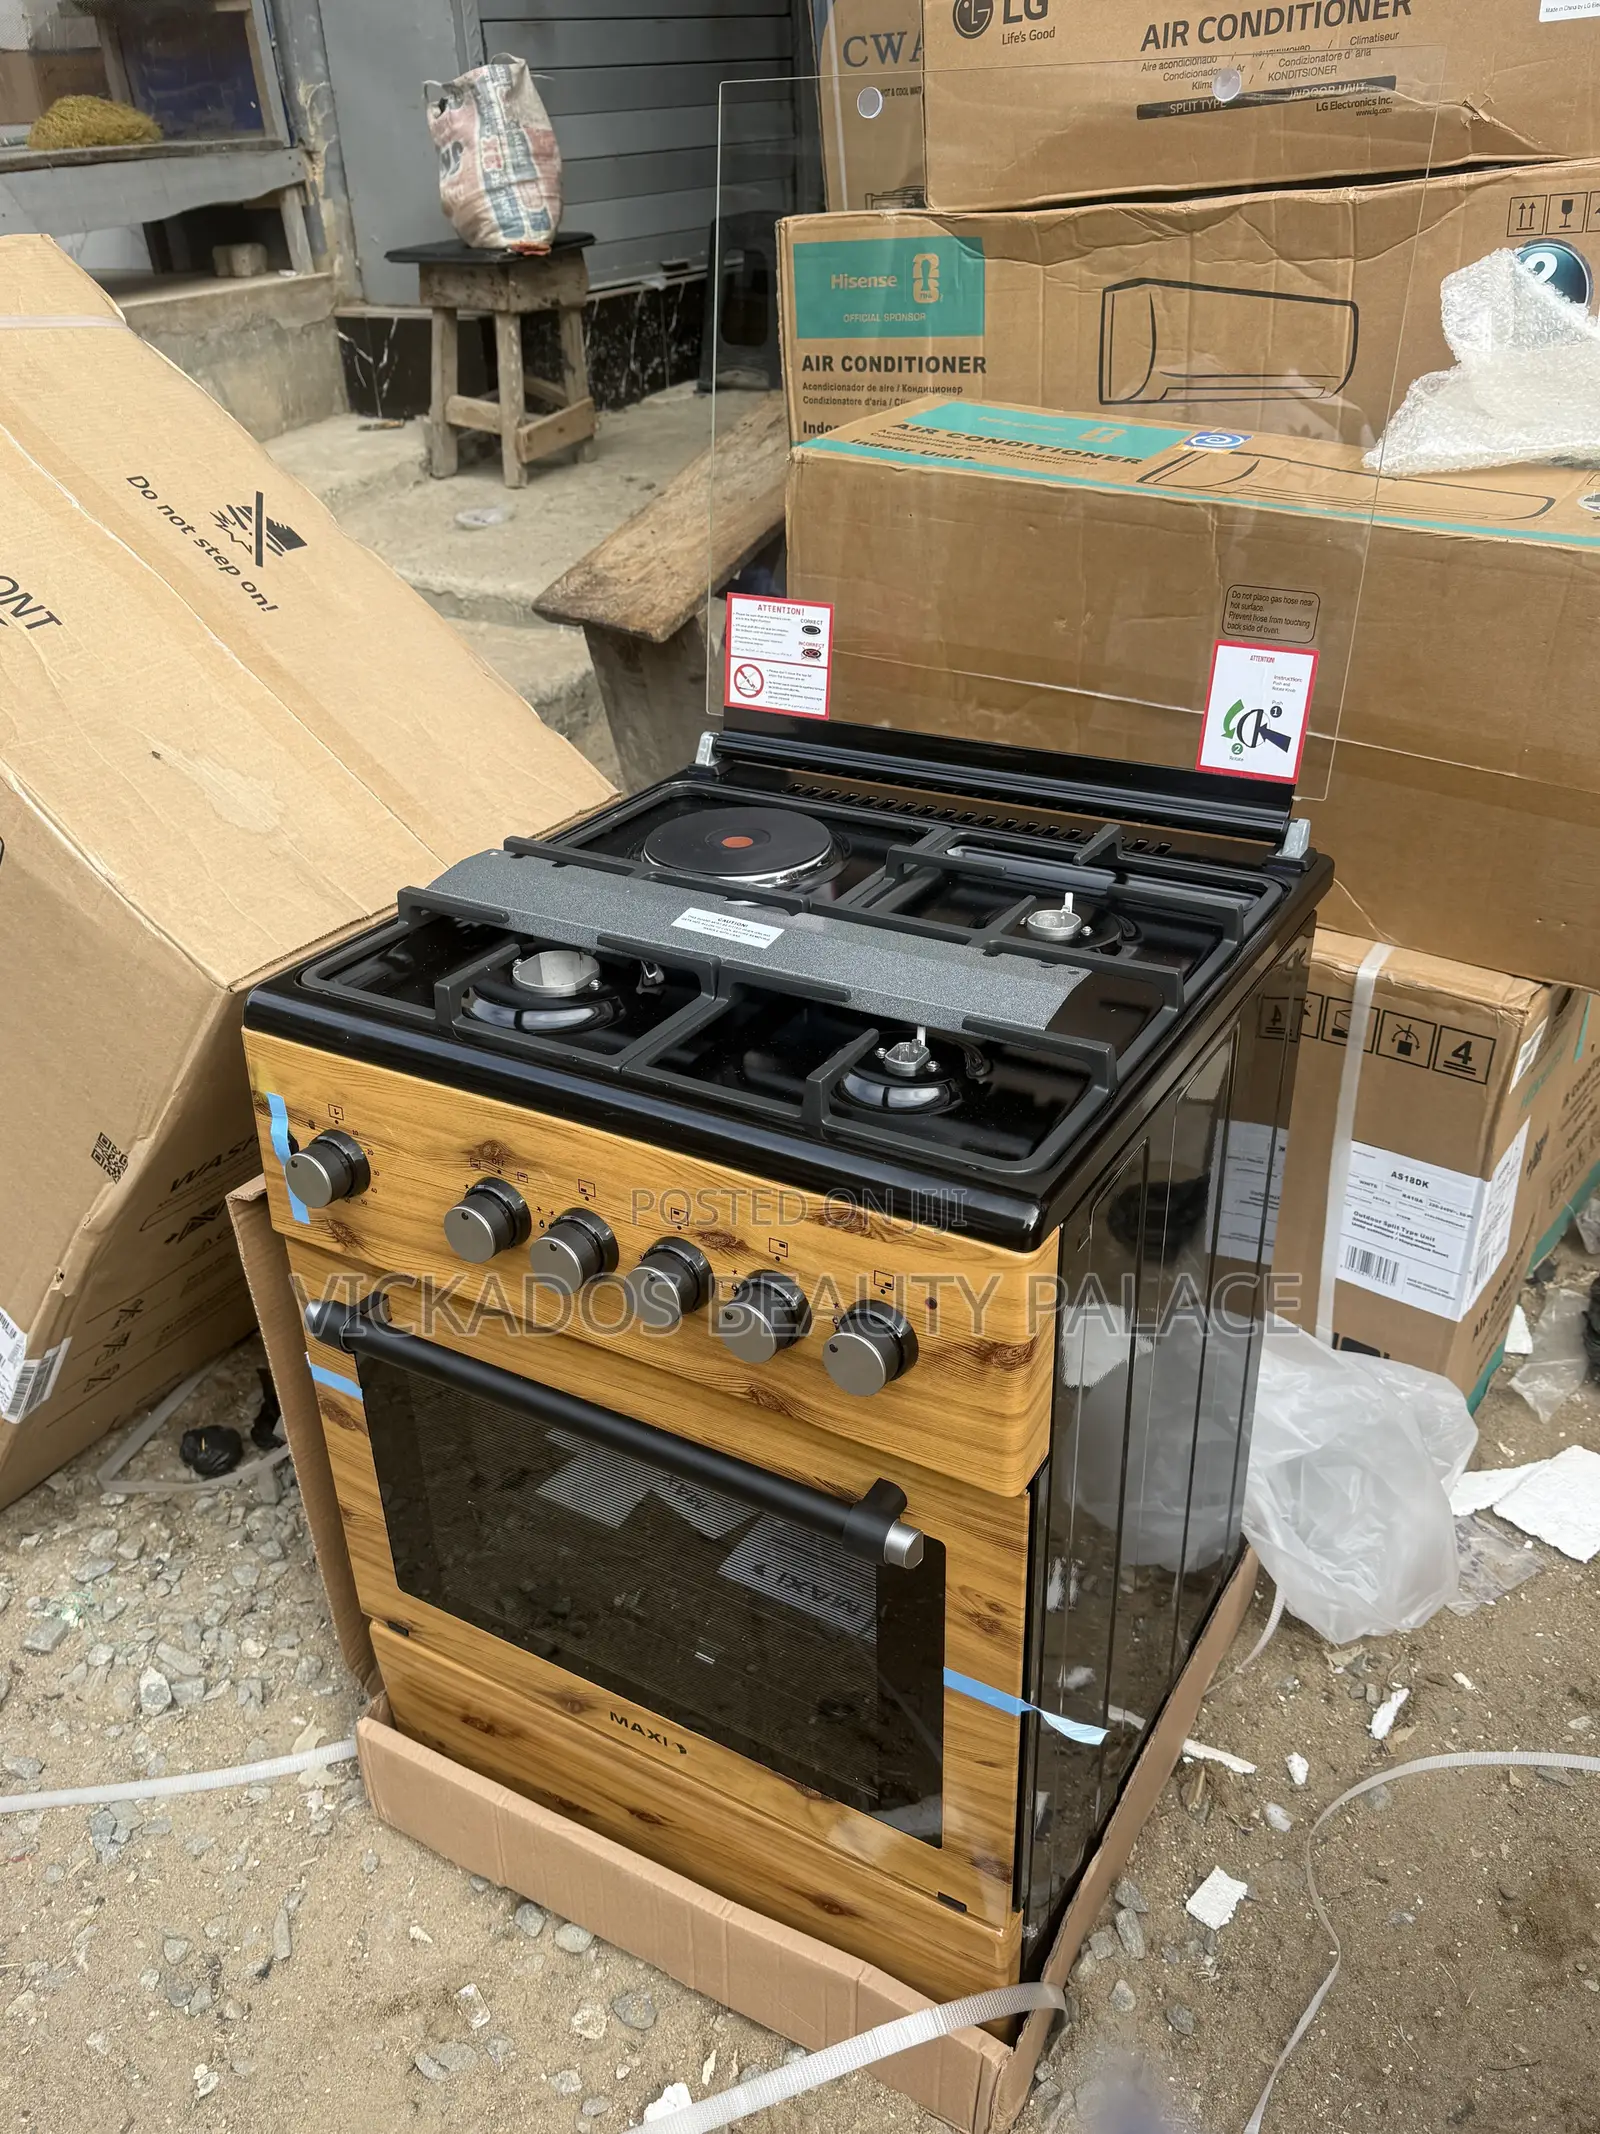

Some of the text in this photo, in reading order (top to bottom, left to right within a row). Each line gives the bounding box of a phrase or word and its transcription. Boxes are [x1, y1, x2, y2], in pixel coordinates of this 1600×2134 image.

[1141, 0, 1412, 51] AIR CONDITIONER
[1002, 26, 1056, 46] Life's Good
[1349, 31, 1399, 47] Climatiseur
[1141, 61, 1157, 72] Aire
[1278, 52, 1342, 68] Condizionatore
[1267, 65, 1338, 82] KONDITSIONER
[1170, 101, 1196, 114] SPLIT
[1316, 97, 1393, 112] LG Electronics Inc.
[831, 274, 898, 290] Hisense
[843, 312, 926, 323] OFFICIAL SPONSOR
[802, 355, 987, 374] AIR CONDITIONER
[802, 382, 864, 392] Acondicionador
[867, 383, 877, 392] de
[879, 383, 895, 393] aire
[902, 384, 963, 395] Кондиционер
[802, 396, 862, 406] Condizionatore
[889, 423, 1144, 465] AIR CONDITIONER
[126, 475, 279, 612] Do not step on!
[1230, 601, 1240, 609] hot
[1231, 590, 1240, 599] Do
[1253, 593, 1269, 602] place
[1270, 596, 1282, 604] gas
[1283, 596, 1298, 604] hose
[757, 604, 805, 616] ATTENTION!
[800, 618, 823, 626] CORRECT
[1227, 622, 1241, 630] back
[1242, 623, 1255, 631] side
[1256, 625, 1263, 633] of
[1228, 611, 1311, 629] Prevent hose from touching
[1451, 1040, 1473, 1065] 4
[1391, 1171, 1429, 1188] AS18DK
[1353, 1210, 1436, 1242] Outdoor Split Type Unit
[610, 1711, 668, 1747] MAXI
